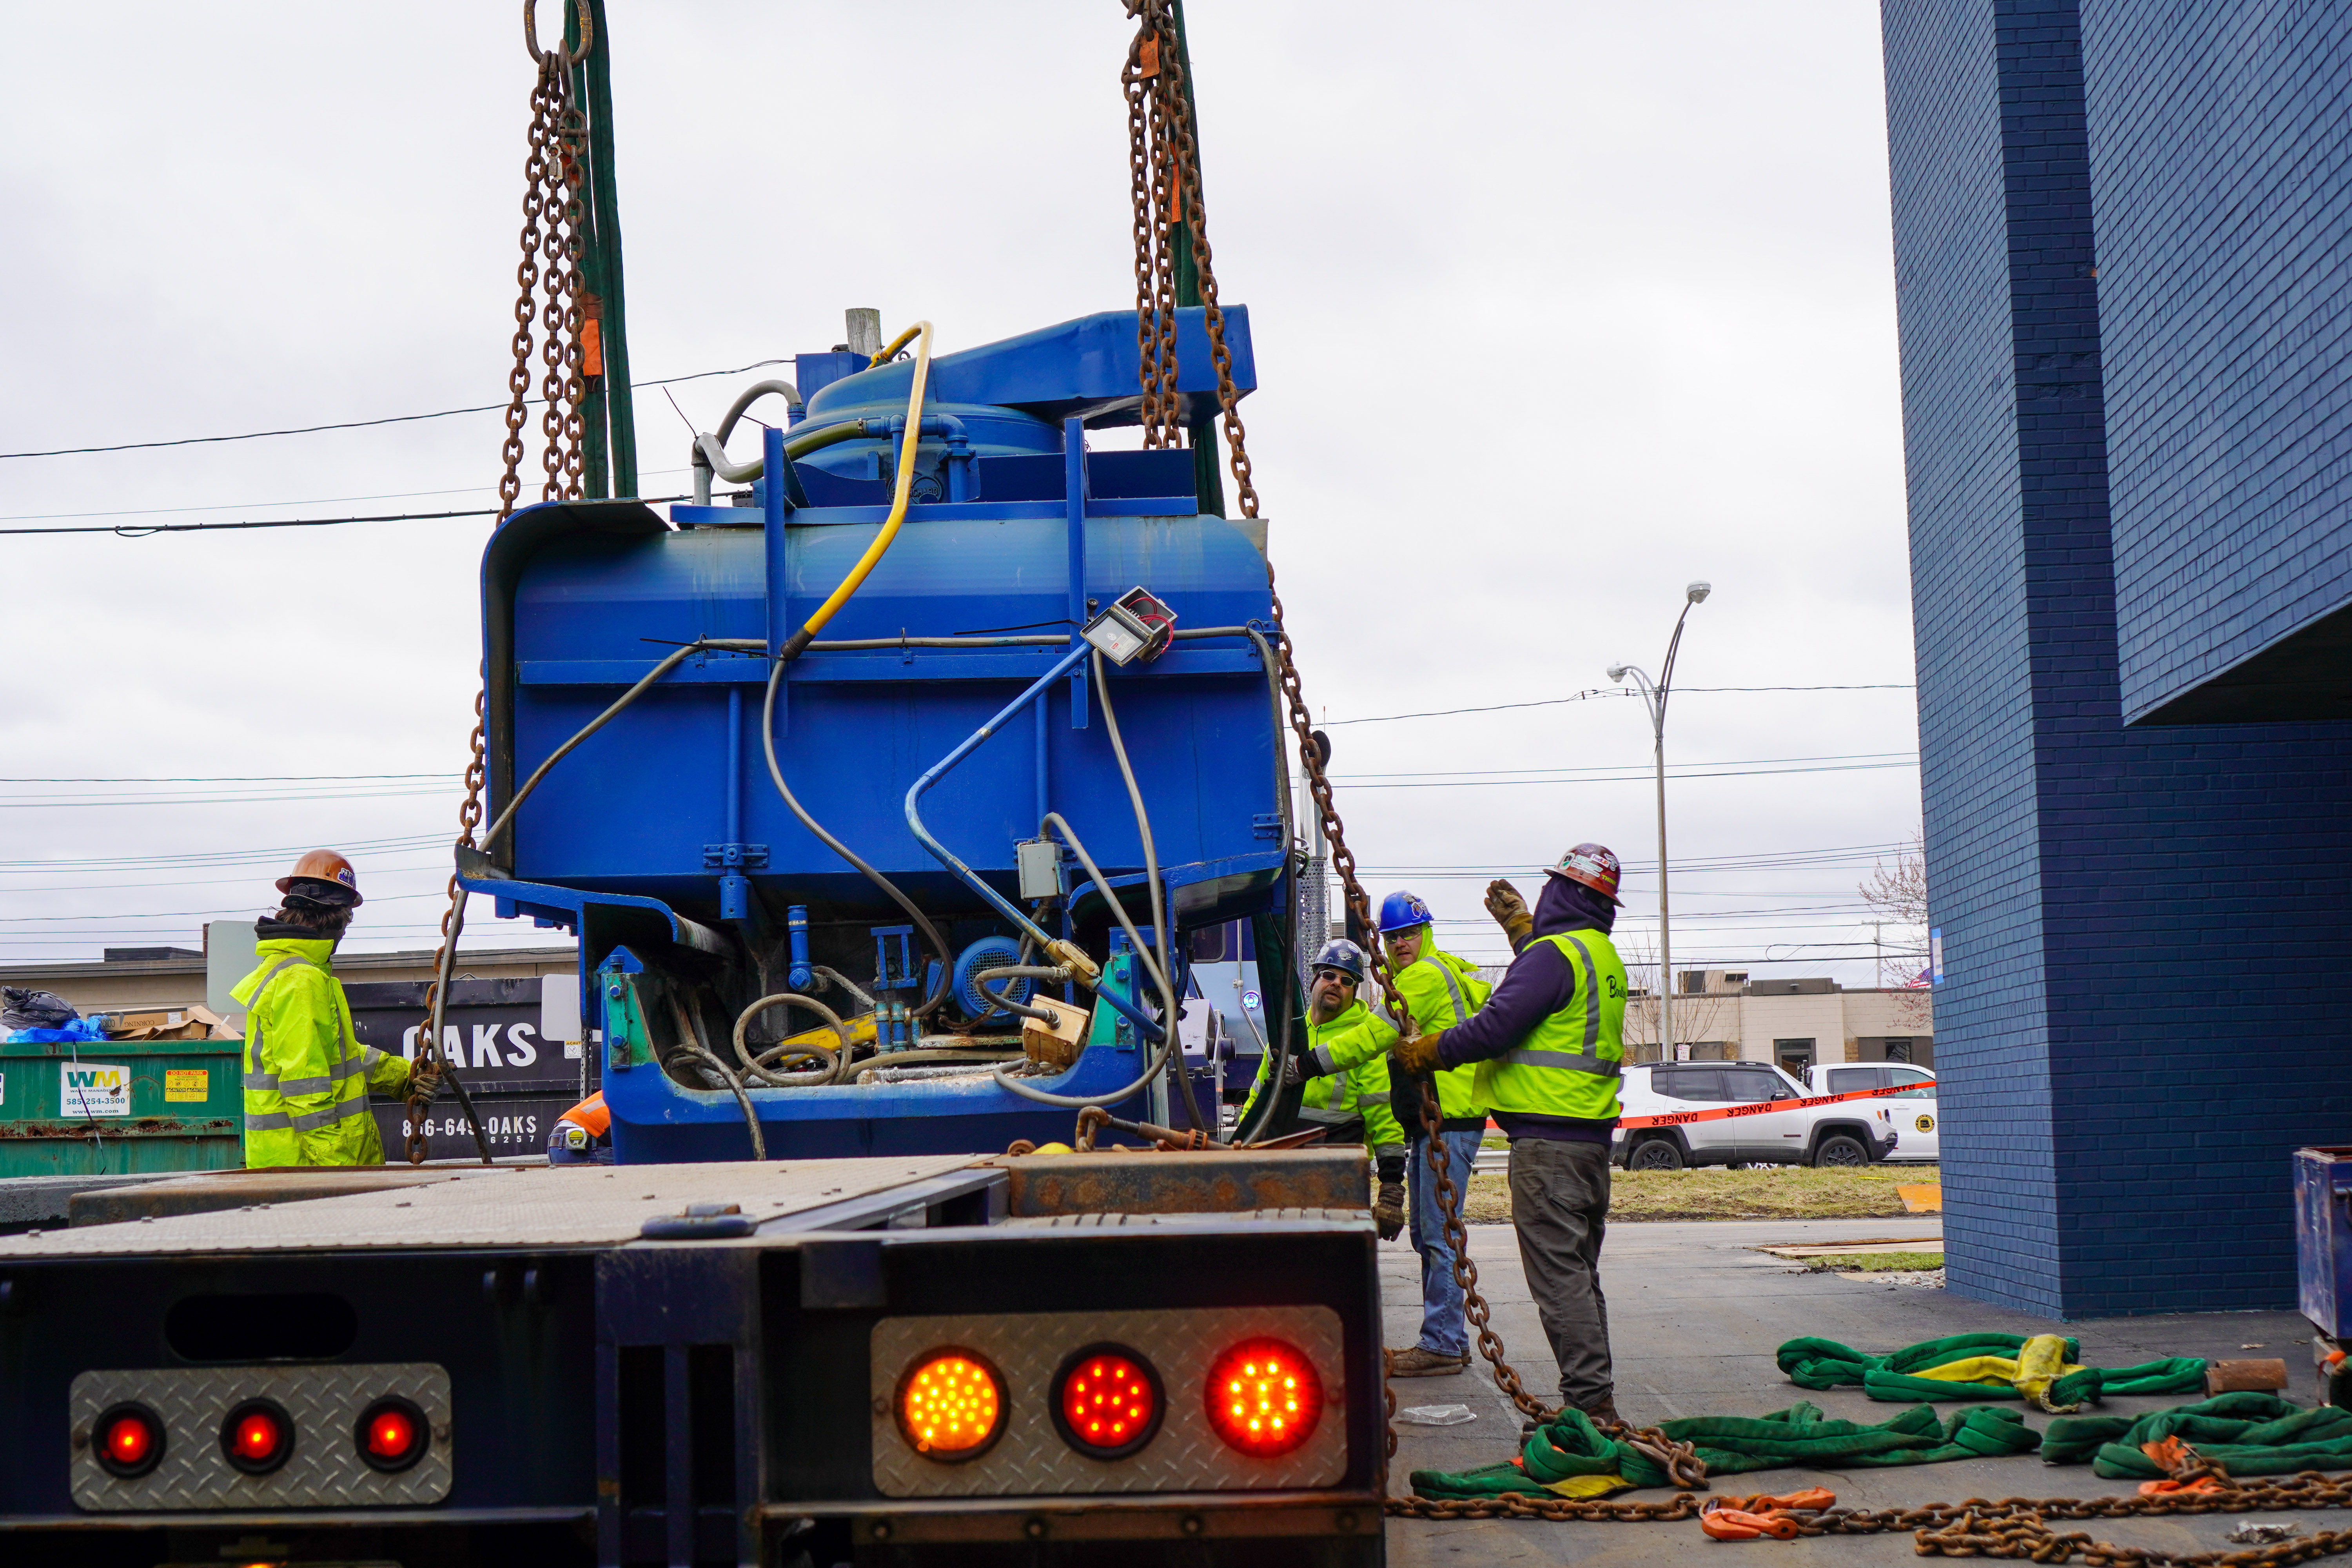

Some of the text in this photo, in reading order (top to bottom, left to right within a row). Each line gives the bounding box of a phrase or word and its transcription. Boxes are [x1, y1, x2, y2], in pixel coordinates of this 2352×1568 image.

[891, 487, 938, 497] BCHARD
[403, 1023, 536, 1068] OAKS
[67, 1071, 121, 1087] WM
[1652, 1084, 1915, 1125] DANGER DANGER DANGER DANGER
[402, 1116, 536, 1137] 86-649-OAKS
